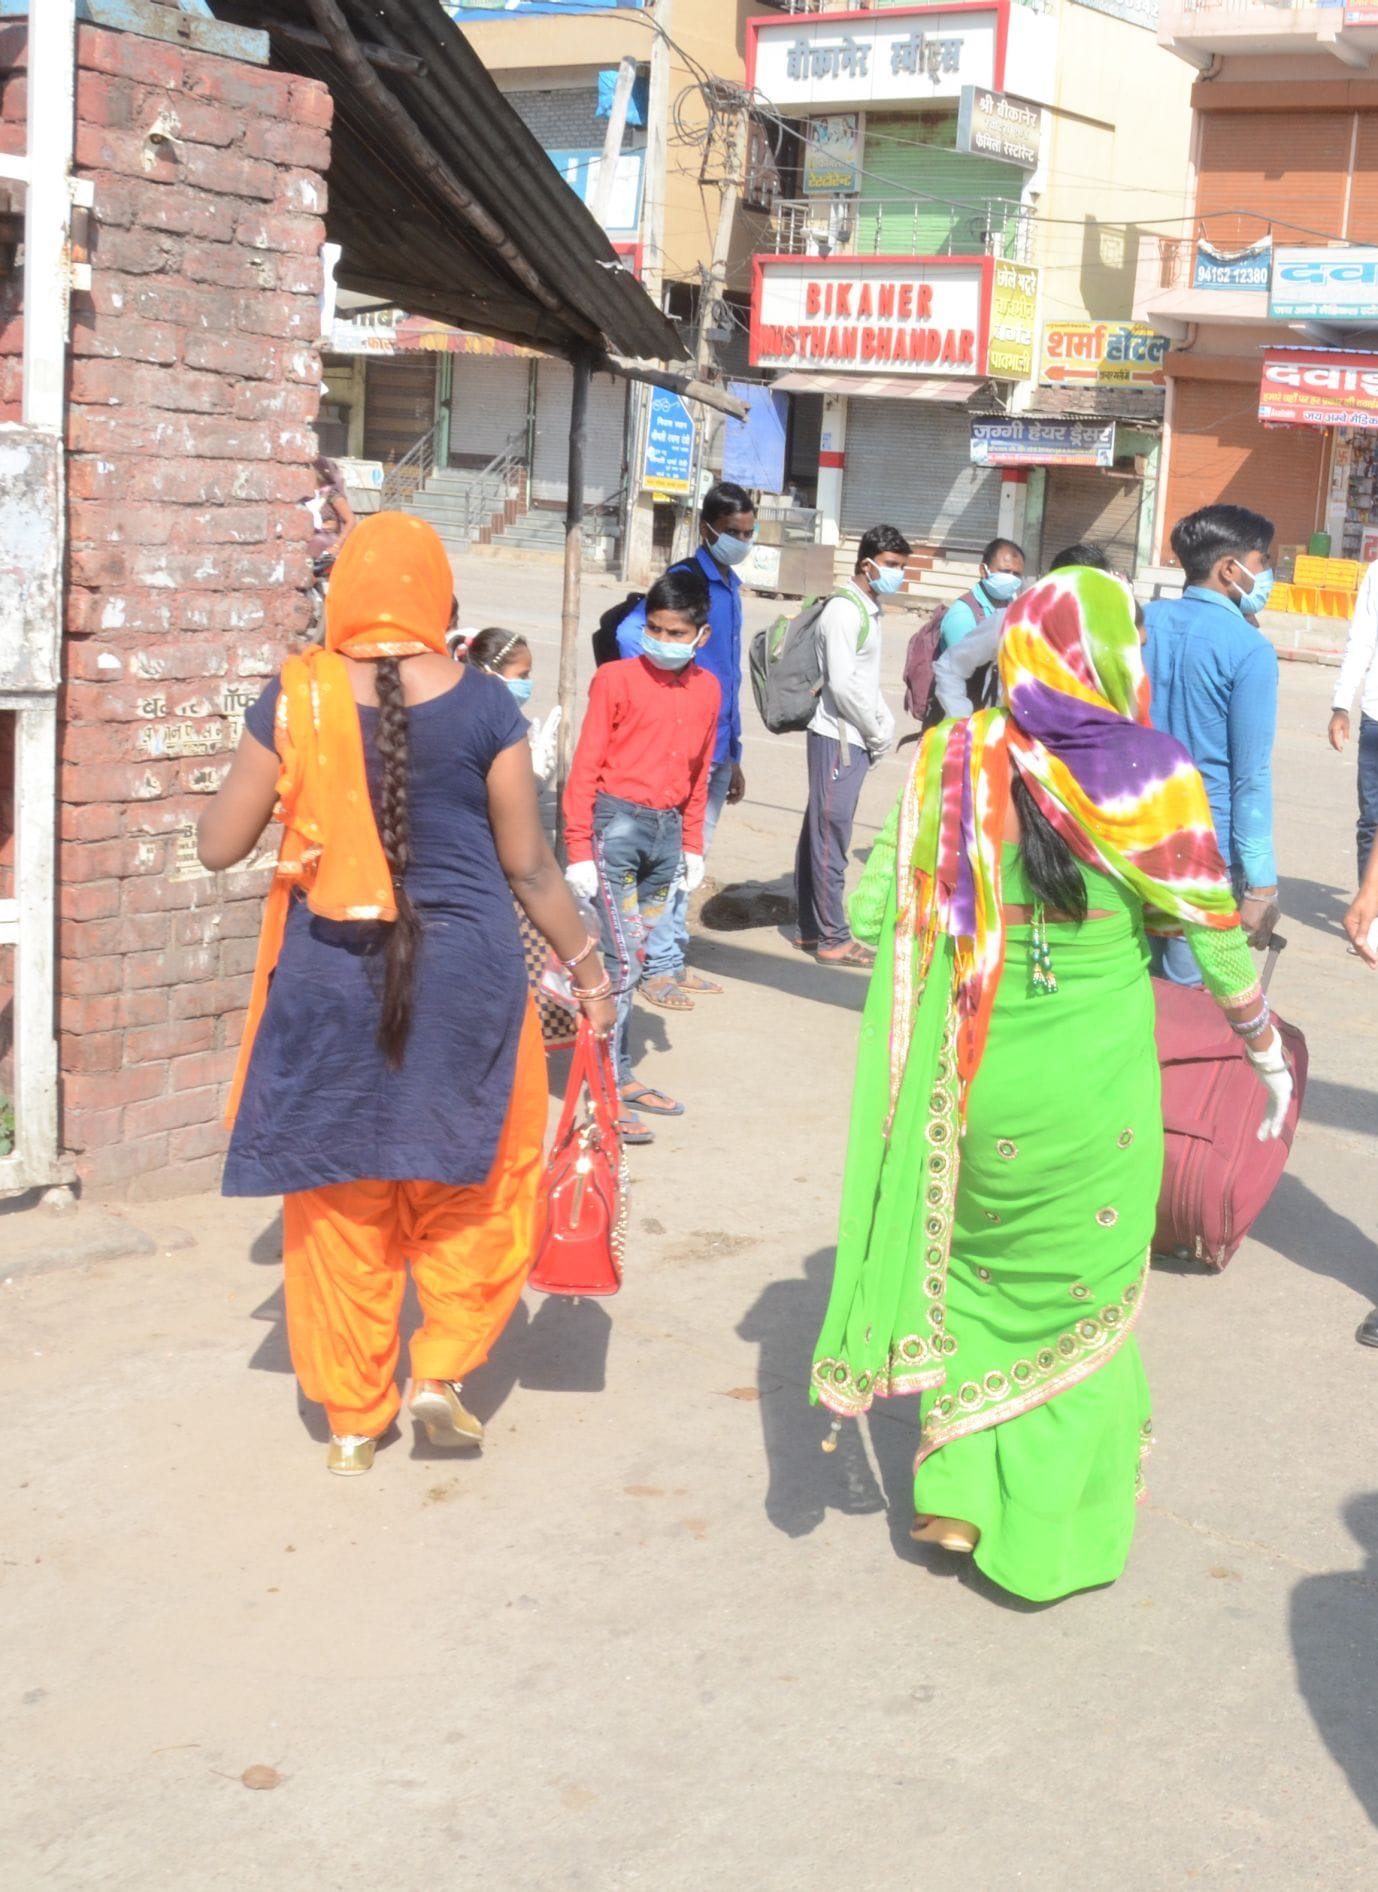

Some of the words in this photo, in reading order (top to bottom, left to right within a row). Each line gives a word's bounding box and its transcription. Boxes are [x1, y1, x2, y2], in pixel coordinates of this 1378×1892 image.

[786, 36, 873, 82] बीकानेर
[979, 94, 994, 115] श्री
[996, 99, 1038, 127] बीकानेर
[1232, 266, 1268, 285] 12380
[805, 282, 934, 319] BIKANER
[860, 325, 976, 367] BHANDAR
[1046, 324, 1108, 359] शर्मा
[1106, 327, 1171, 362] होटल
[973, 420, 1024, 440] जग्गी
[1028, 421, 1068, 441] हेयर
[1304, 412, 1322, 423] जय
[1325, 411, 1347, 425] अम्बे
